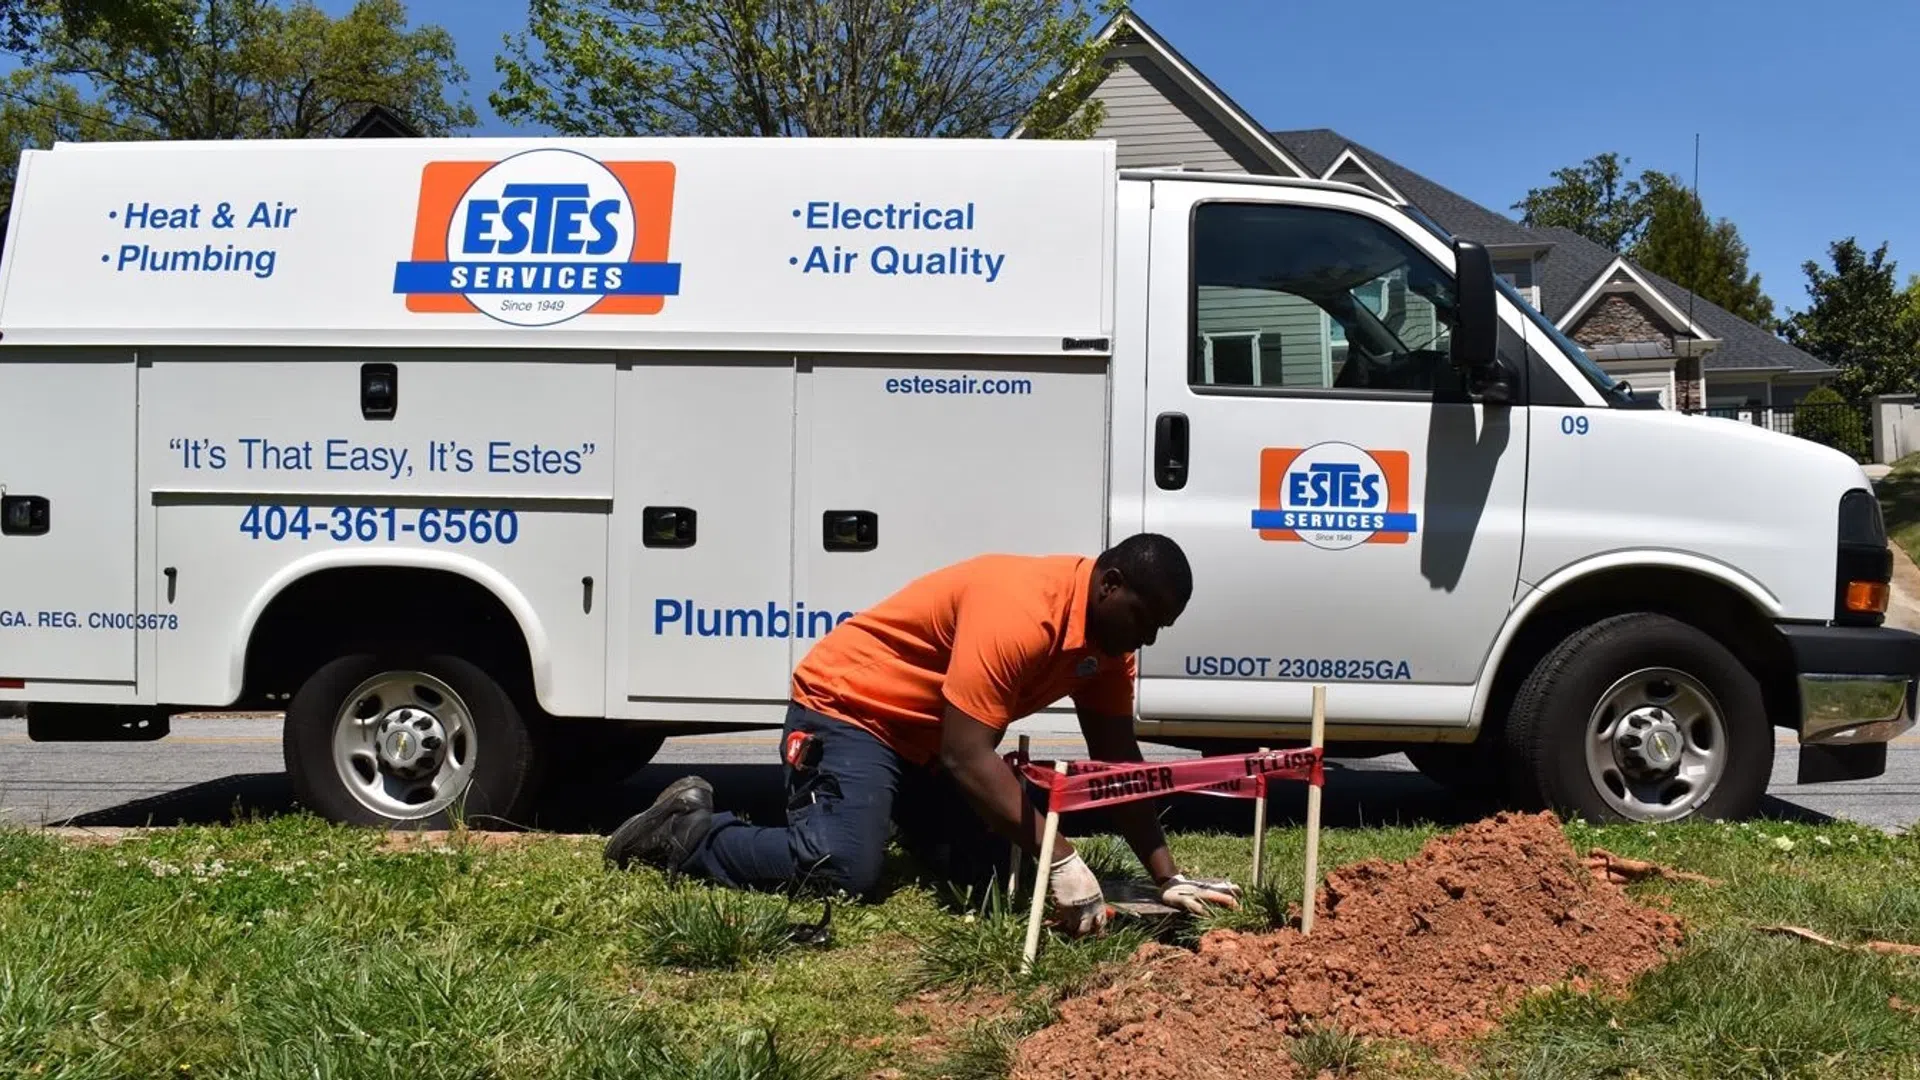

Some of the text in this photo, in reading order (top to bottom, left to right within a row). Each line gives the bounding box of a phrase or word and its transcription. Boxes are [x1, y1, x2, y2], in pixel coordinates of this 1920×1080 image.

[124, 201, 298, 231] Heat & Air
[462, 183, 622, 256] ESTES
[804, 200, 976, 232] Electrical
[116, 242, 278, 280] Plumbing
[802, 244, 1006, 285] Air Quality
[450, 266, 623, 290] SERVICES
[500, 300, 566, 313] Since 1949
[884, 375, 1033, 396] estesair.com
[1559, 415, 1590, 436] 09
[238, 439, 313, 471] That
[324, 440, 414, 480] Easy,
[427, 441, 474, 473] It’s
[1289, 462, 1380, 509] ESTES
[239, 504, 520, 546] 404-361-6560
[1284, 512, 1385, 529] SERVICES
[0, 610, 179, 630] GA. REG. CN003678
[653, 598, 855, 639] Plumbin
[1184, 655, 1413, 681] USDOT 2308825GA
[1088, 766, 1175, 801] DANGER
